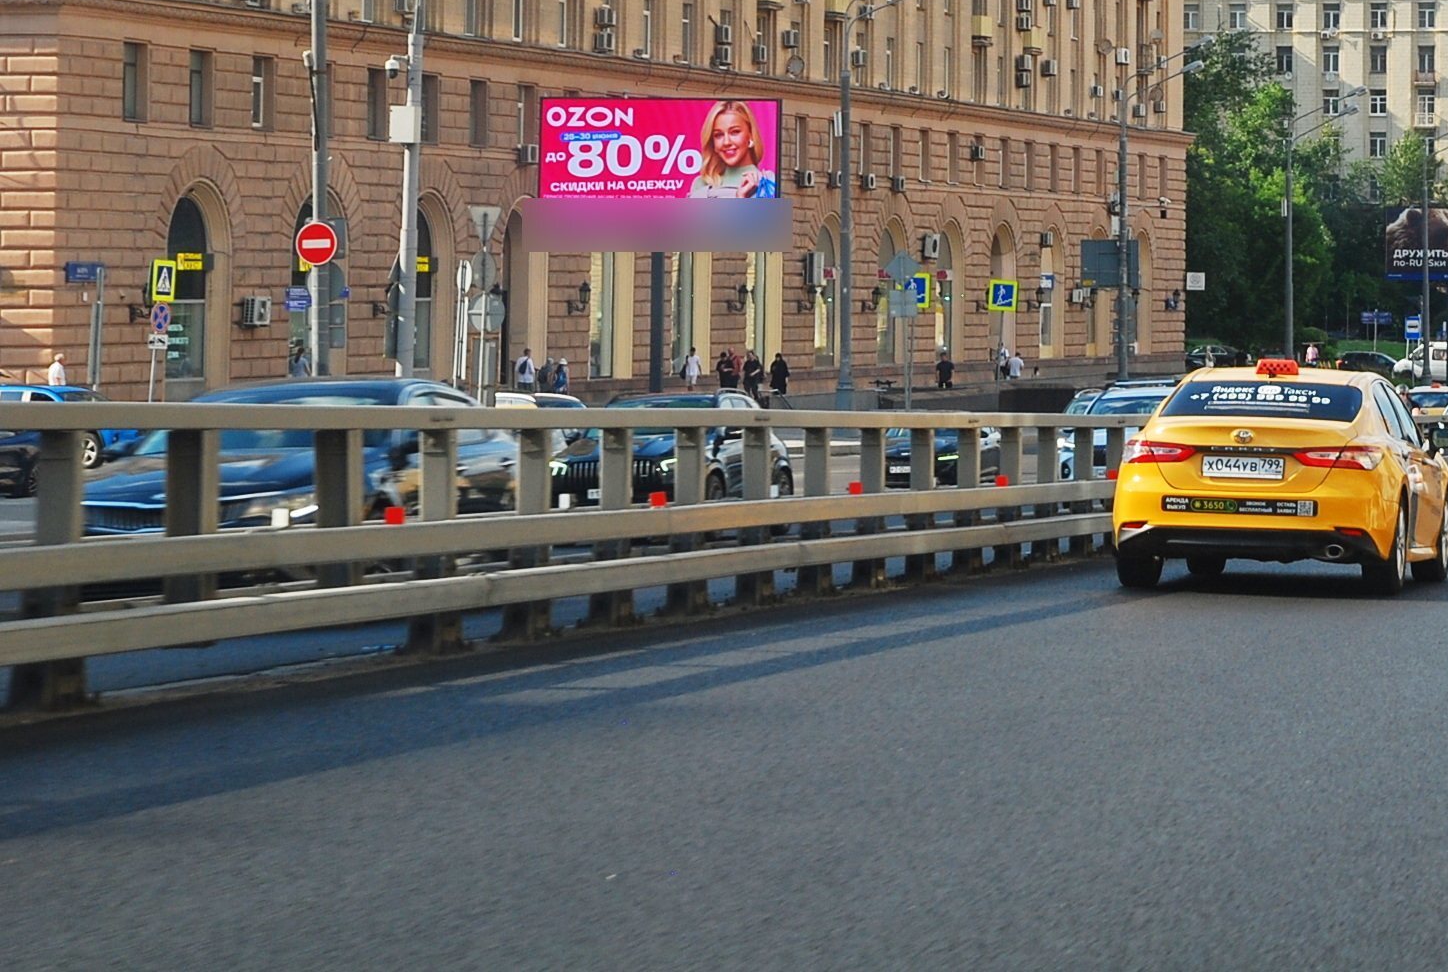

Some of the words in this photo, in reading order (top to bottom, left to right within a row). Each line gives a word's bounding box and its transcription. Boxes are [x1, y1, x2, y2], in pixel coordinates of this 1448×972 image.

[546, 106, 634, 127] OZON
[545, 151, 567, 163] до
[567, 134, 703, 178] 80%
[550, 180, 605, 192] СКИДКИ
[607, 180, 623, 191] НА
[627, 179, 684, 191] ОДЕЖДУ
[1393, 258, 1446, 267] по-RUSки
[1190, 392, 1209, 400] +7
[1211, 385, 1256, 394] Яндекс
[1283, 386, 1317, 396] Такси
[1261, 459, 1280, 469] 799
